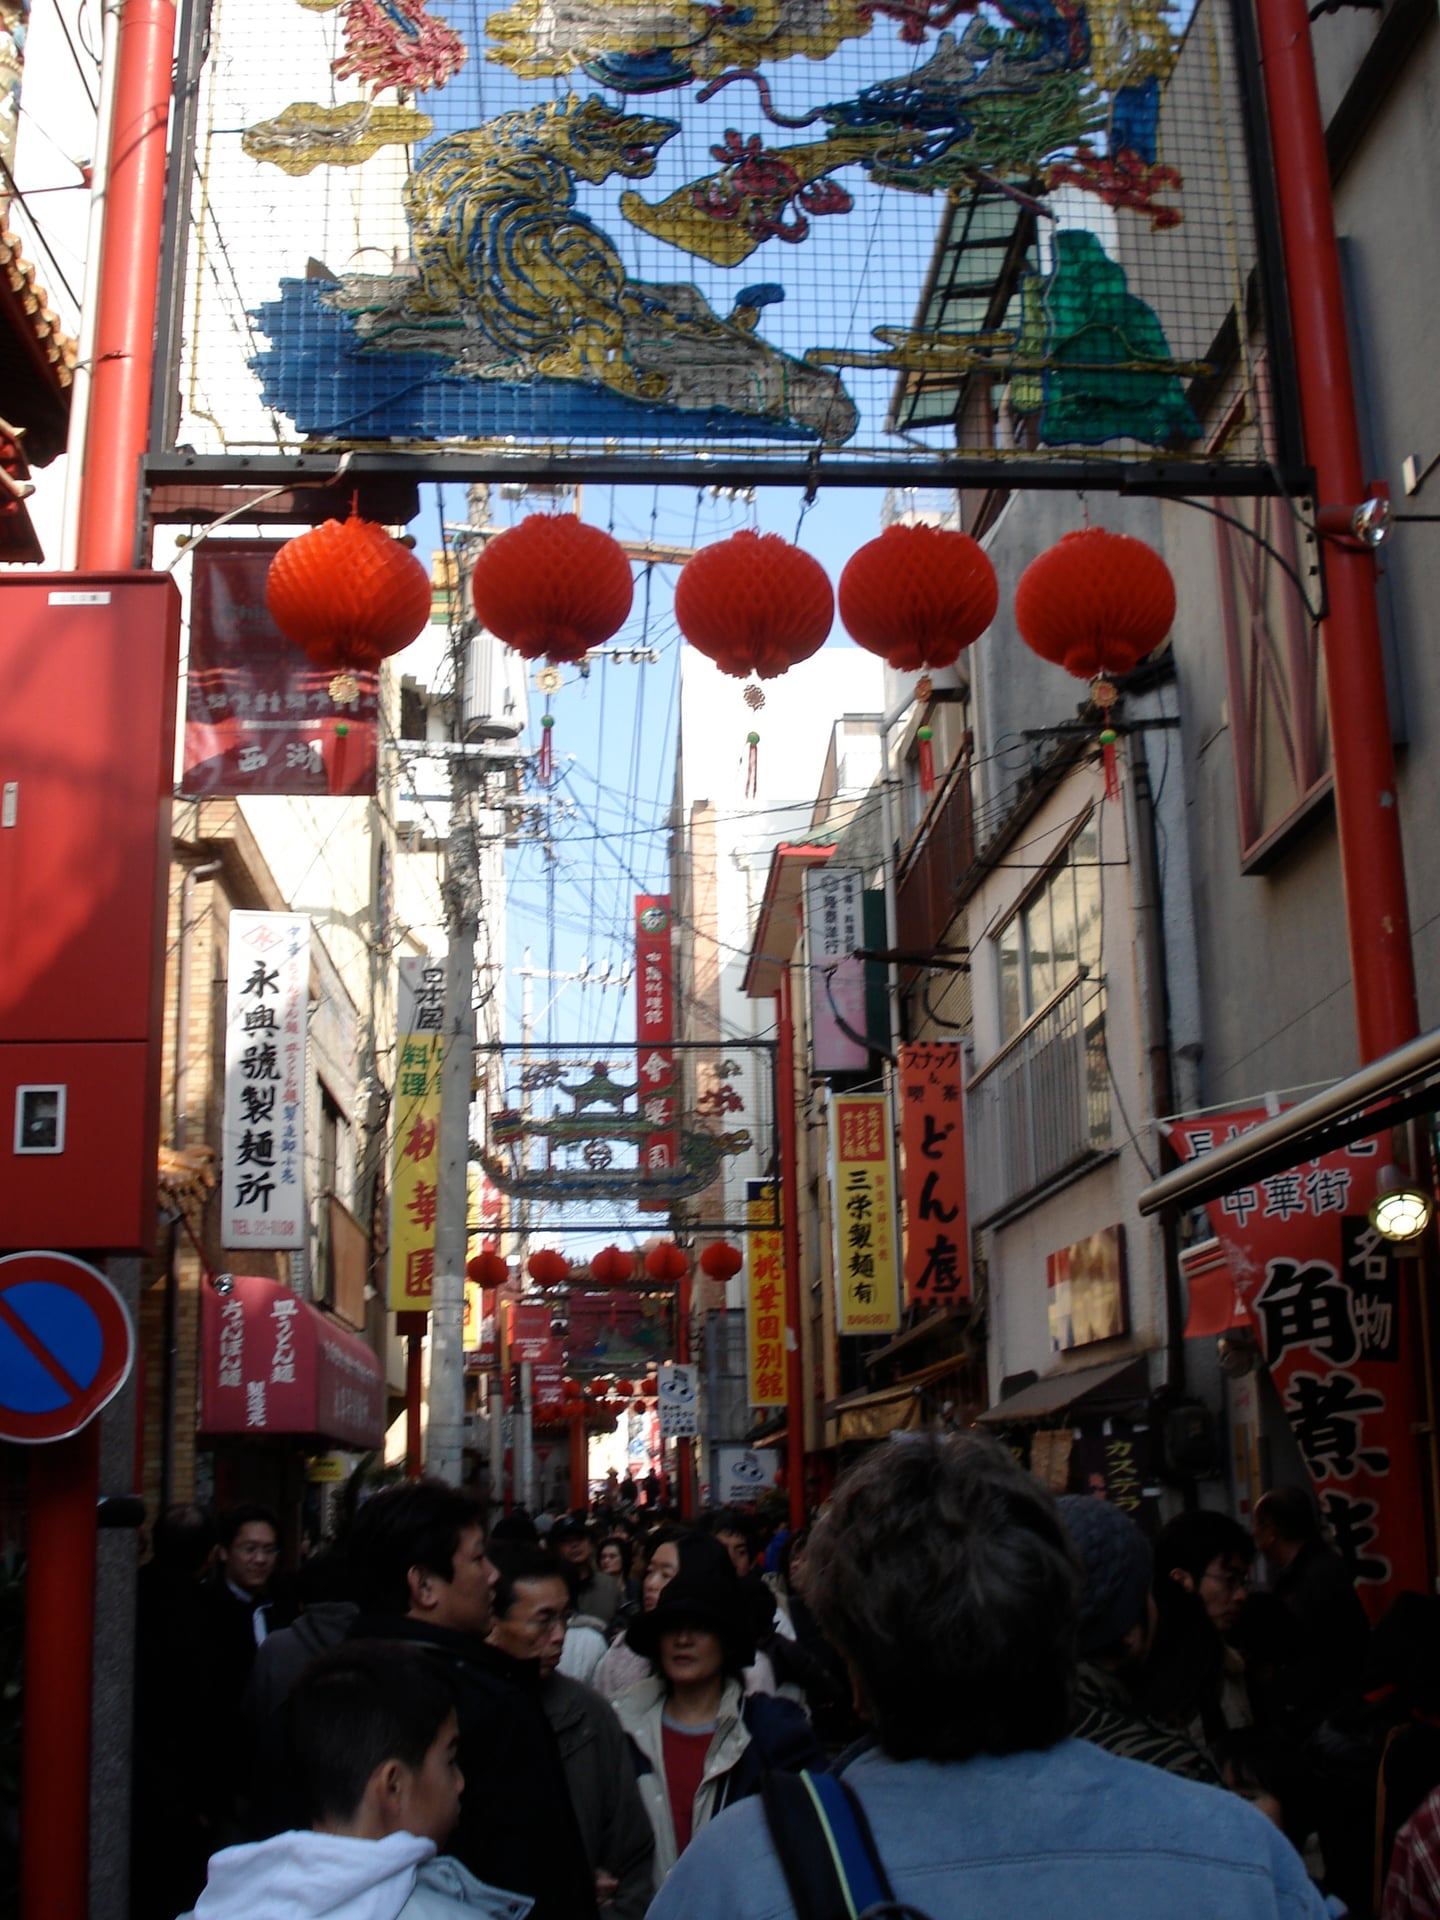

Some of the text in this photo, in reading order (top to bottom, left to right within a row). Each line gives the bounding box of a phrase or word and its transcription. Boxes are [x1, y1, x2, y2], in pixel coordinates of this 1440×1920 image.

[400, 1044, 428, 1096] 料理
[905, 1052, 958, 1070] スナック
[916, 1114, 961, 1293] どん底
[1221, 1169, 1352, 1228] 中華街
[1349, 1226, 1393, 1350] 名物
[218, 1299, 244, 1387] ちゃんぽん麺
[1105, 1440, 1141, 1512] カステラ
